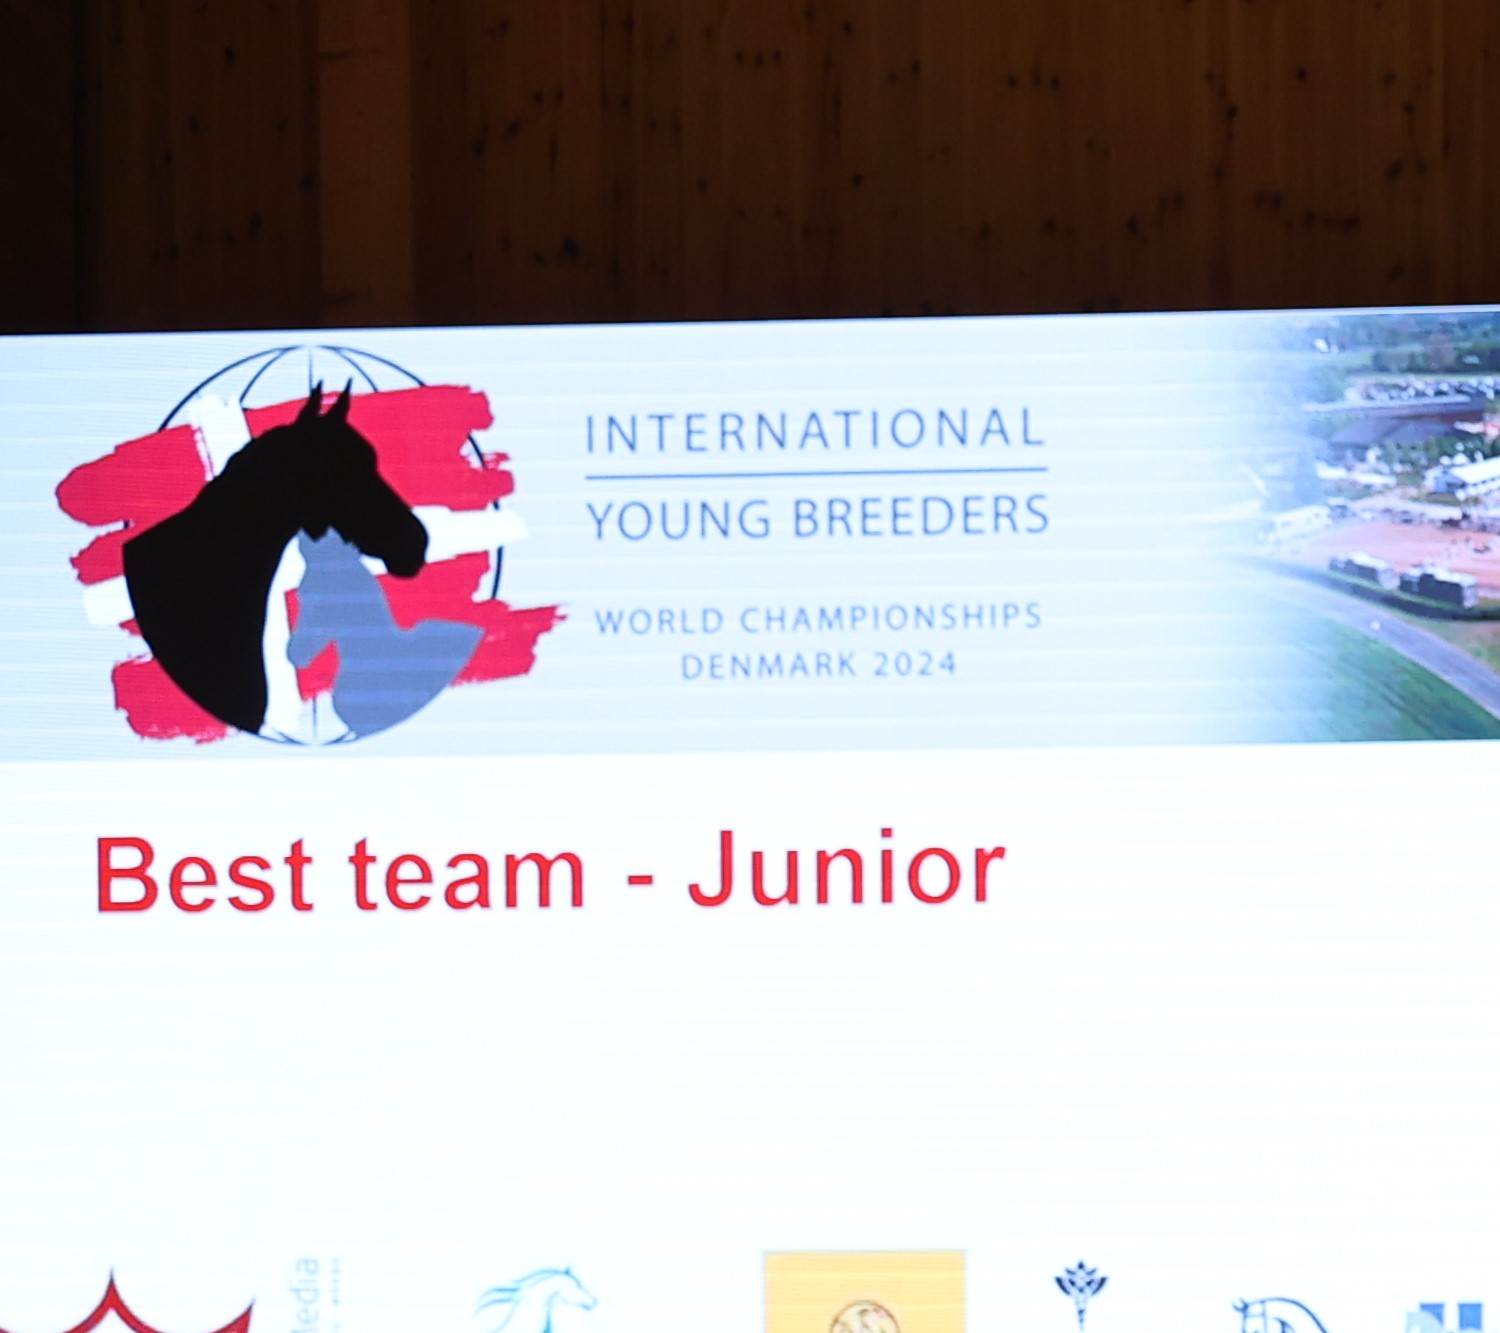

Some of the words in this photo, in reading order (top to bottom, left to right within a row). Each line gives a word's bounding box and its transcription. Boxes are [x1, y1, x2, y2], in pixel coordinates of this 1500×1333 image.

[586, 407, 1045, 454] INTERNATIONAL
[585, 498, 771, 542] YOUNG
[793, 493, 1049, 539] BREEDERS
[594, 607, 724, 636] WORLD
[739, 601, 1042, 635] CHAMPIONSHIPS
[681, 651, 857, 681] DENMARK
[873, 650, 957, 678] 2024
[96, 836, 315, 914] Best
[347, 837, 584, 912] team
[687, 827, 1007, 908] Junior
